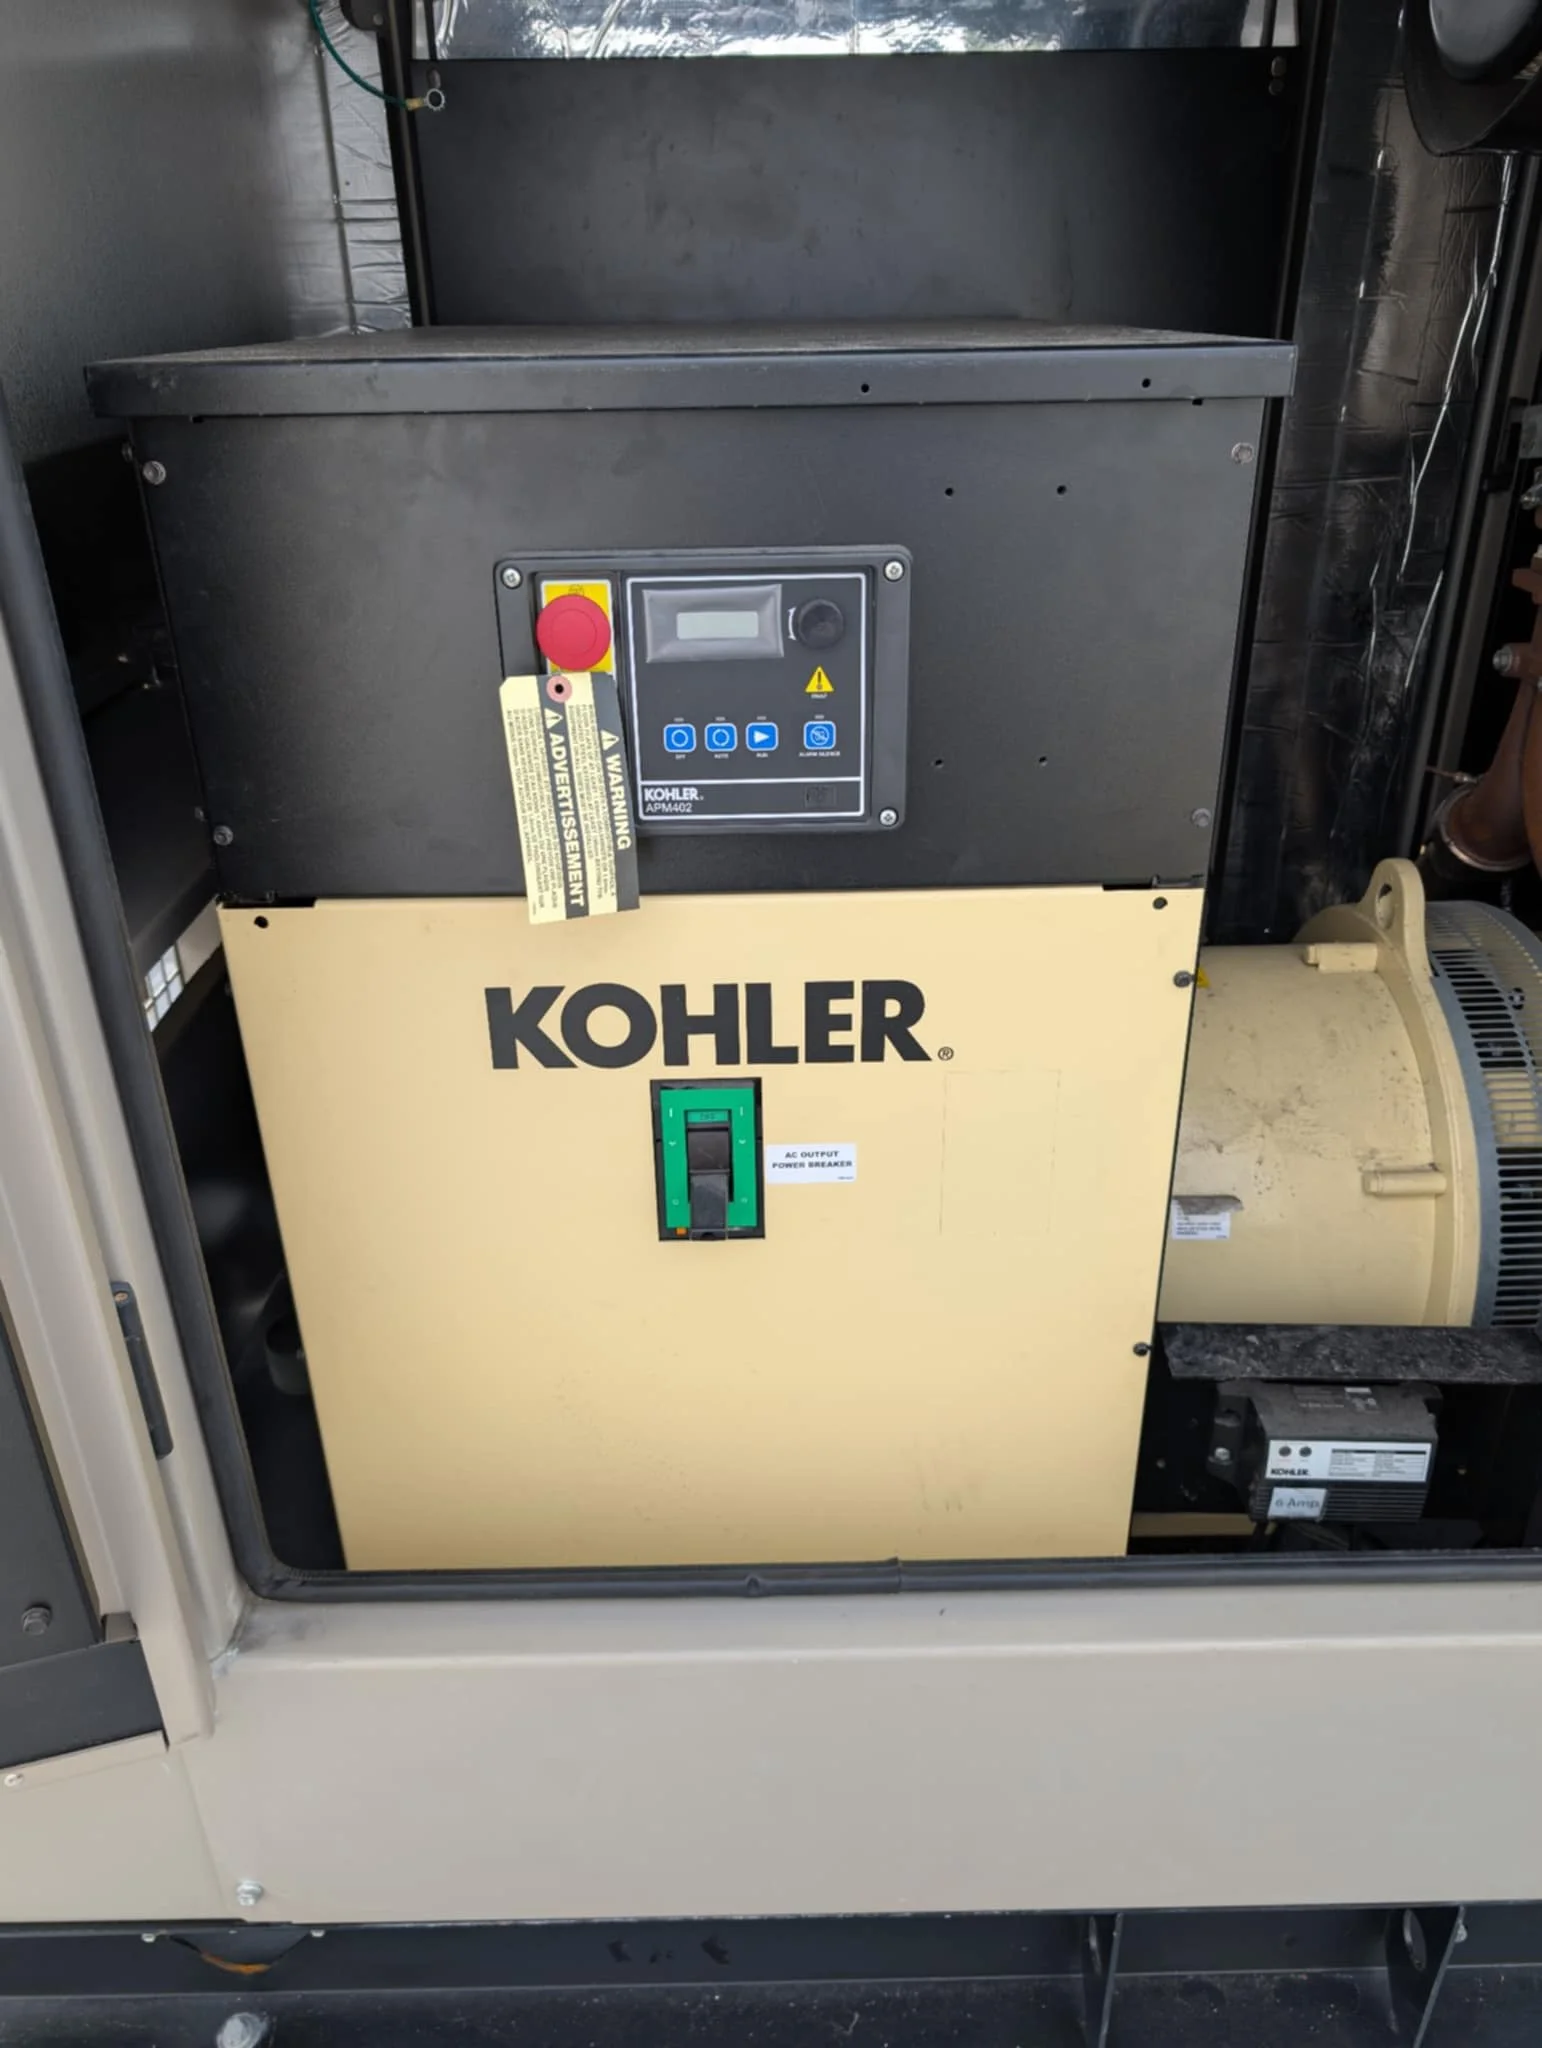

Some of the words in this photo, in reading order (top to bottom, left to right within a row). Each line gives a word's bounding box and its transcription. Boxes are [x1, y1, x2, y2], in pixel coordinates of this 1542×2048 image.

[644, 787, 699, 801] KOHLER
[605, 753, 631, 850] WARNING
[645, 802, 692, 813] APM402
[549, 732, 584, 907] ADVERTISSEMENT
[485, 980, 932, 1069] KOHLER
[808, 1160, 853, 1168] BREAKER
[1287, 1497, 1320, 1509] Amp
